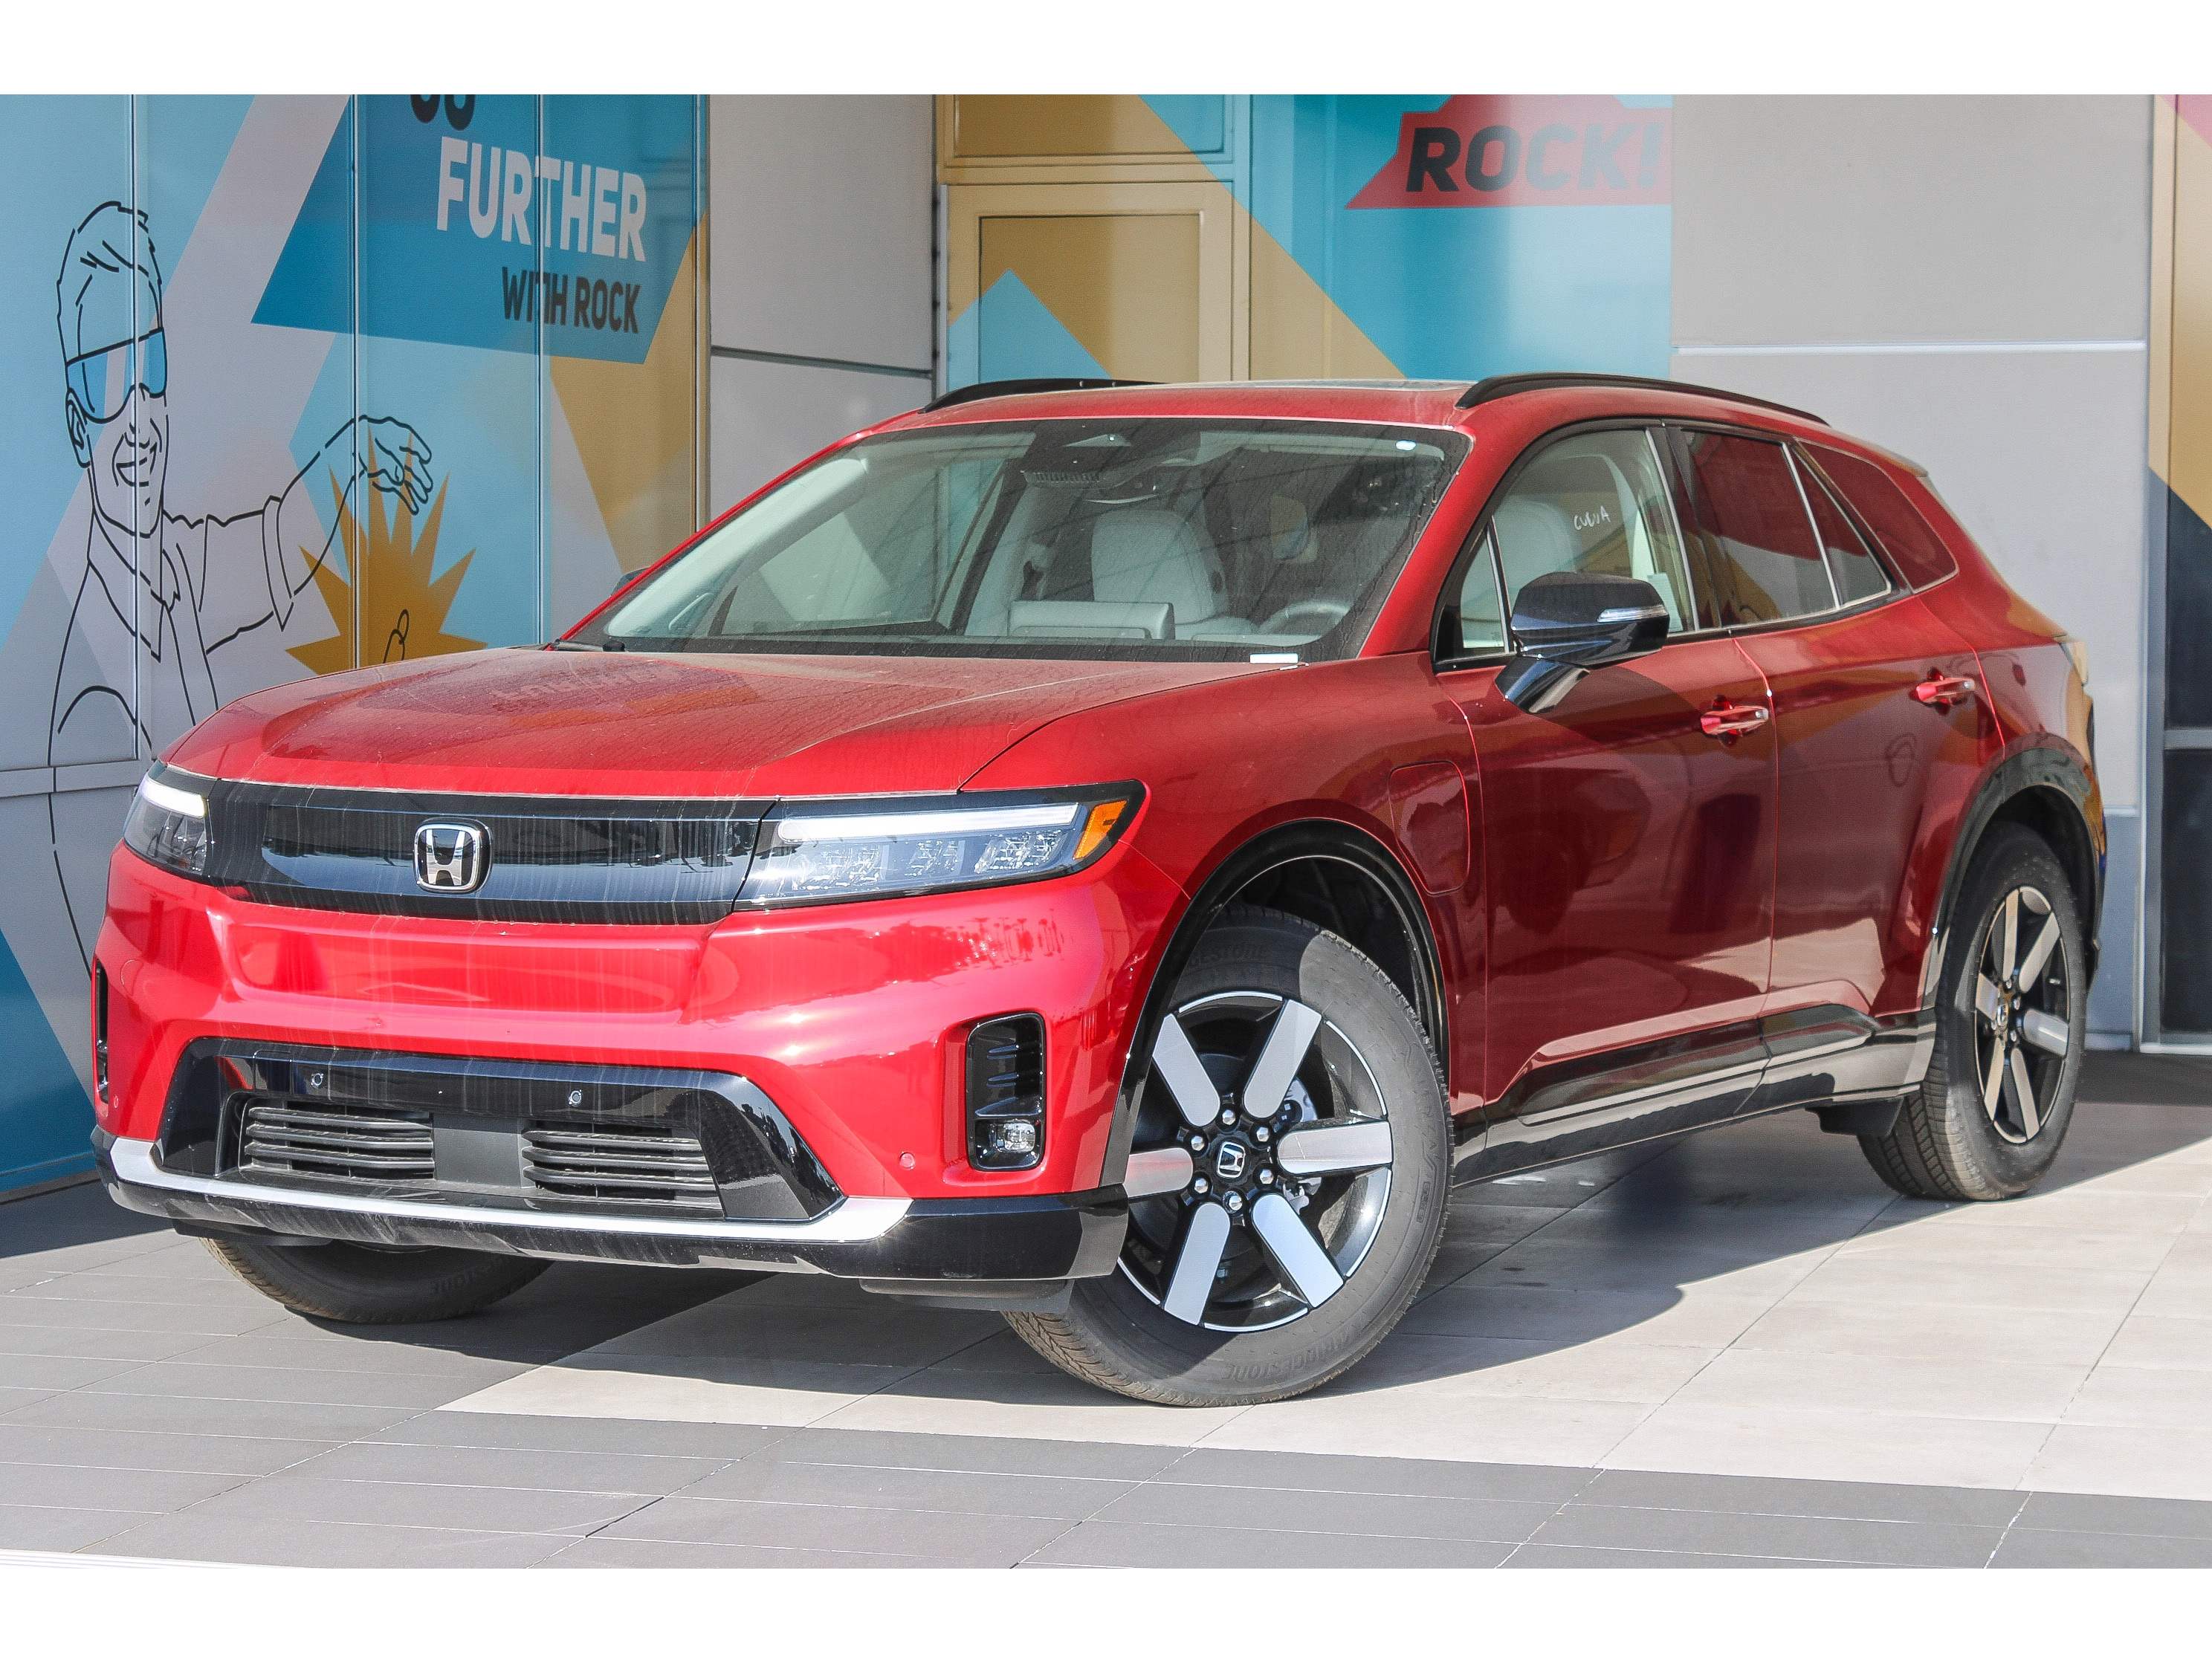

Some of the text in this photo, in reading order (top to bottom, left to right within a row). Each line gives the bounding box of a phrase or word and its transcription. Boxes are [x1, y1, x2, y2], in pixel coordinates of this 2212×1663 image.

[437, 136, 647, 262] FURTHER
[502, 265, 642, 334] WITH ROCK
